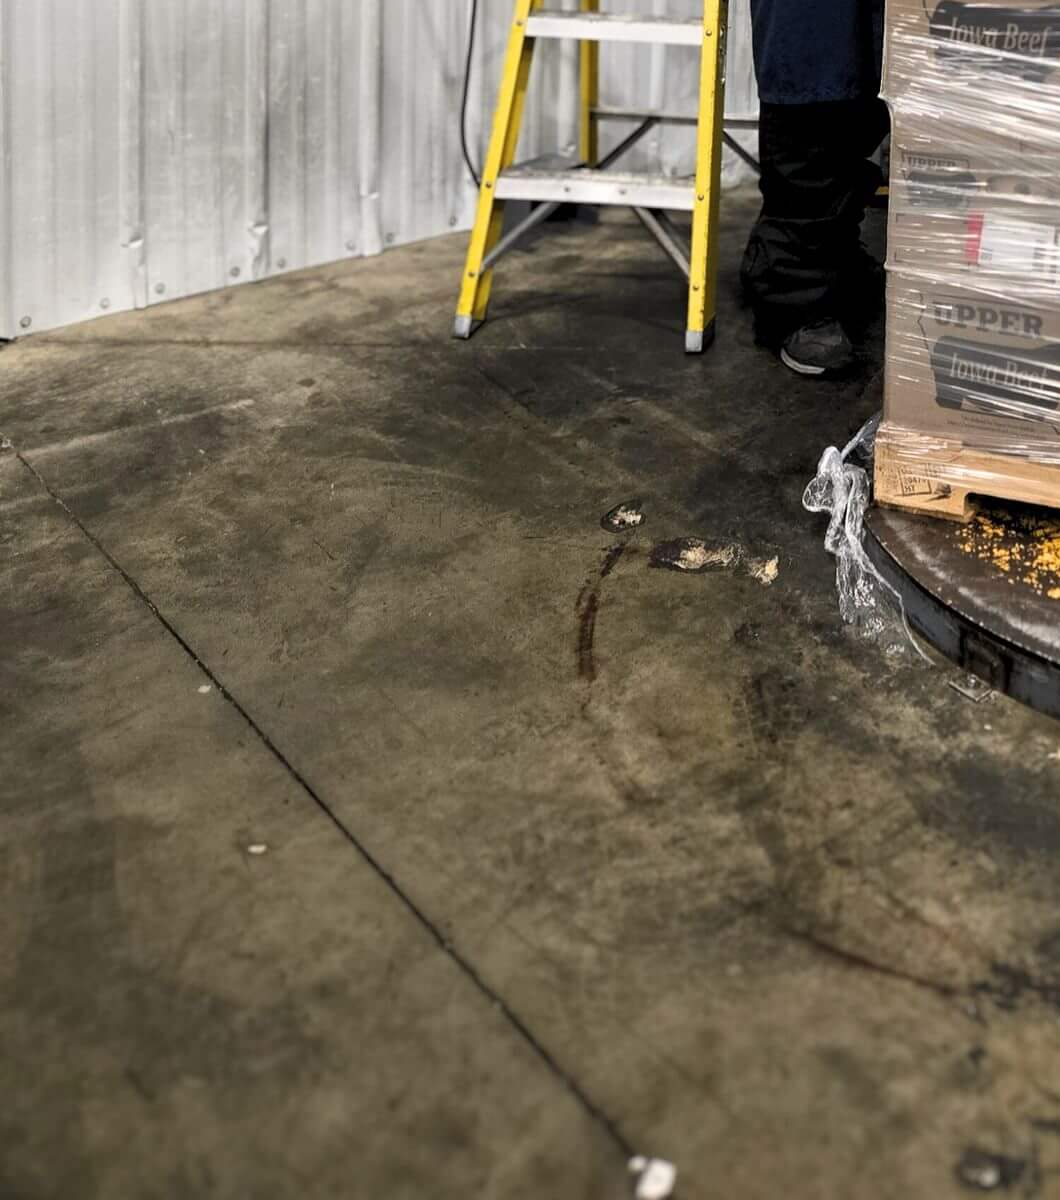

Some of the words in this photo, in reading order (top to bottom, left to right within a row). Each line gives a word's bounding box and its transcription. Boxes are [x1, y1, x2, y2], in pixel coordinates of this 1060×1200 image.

[950, 17, 998, 48] Iowa
[1004, 23, 1053, 58] Beef
[933, 301, 1045, 340] UPPER
